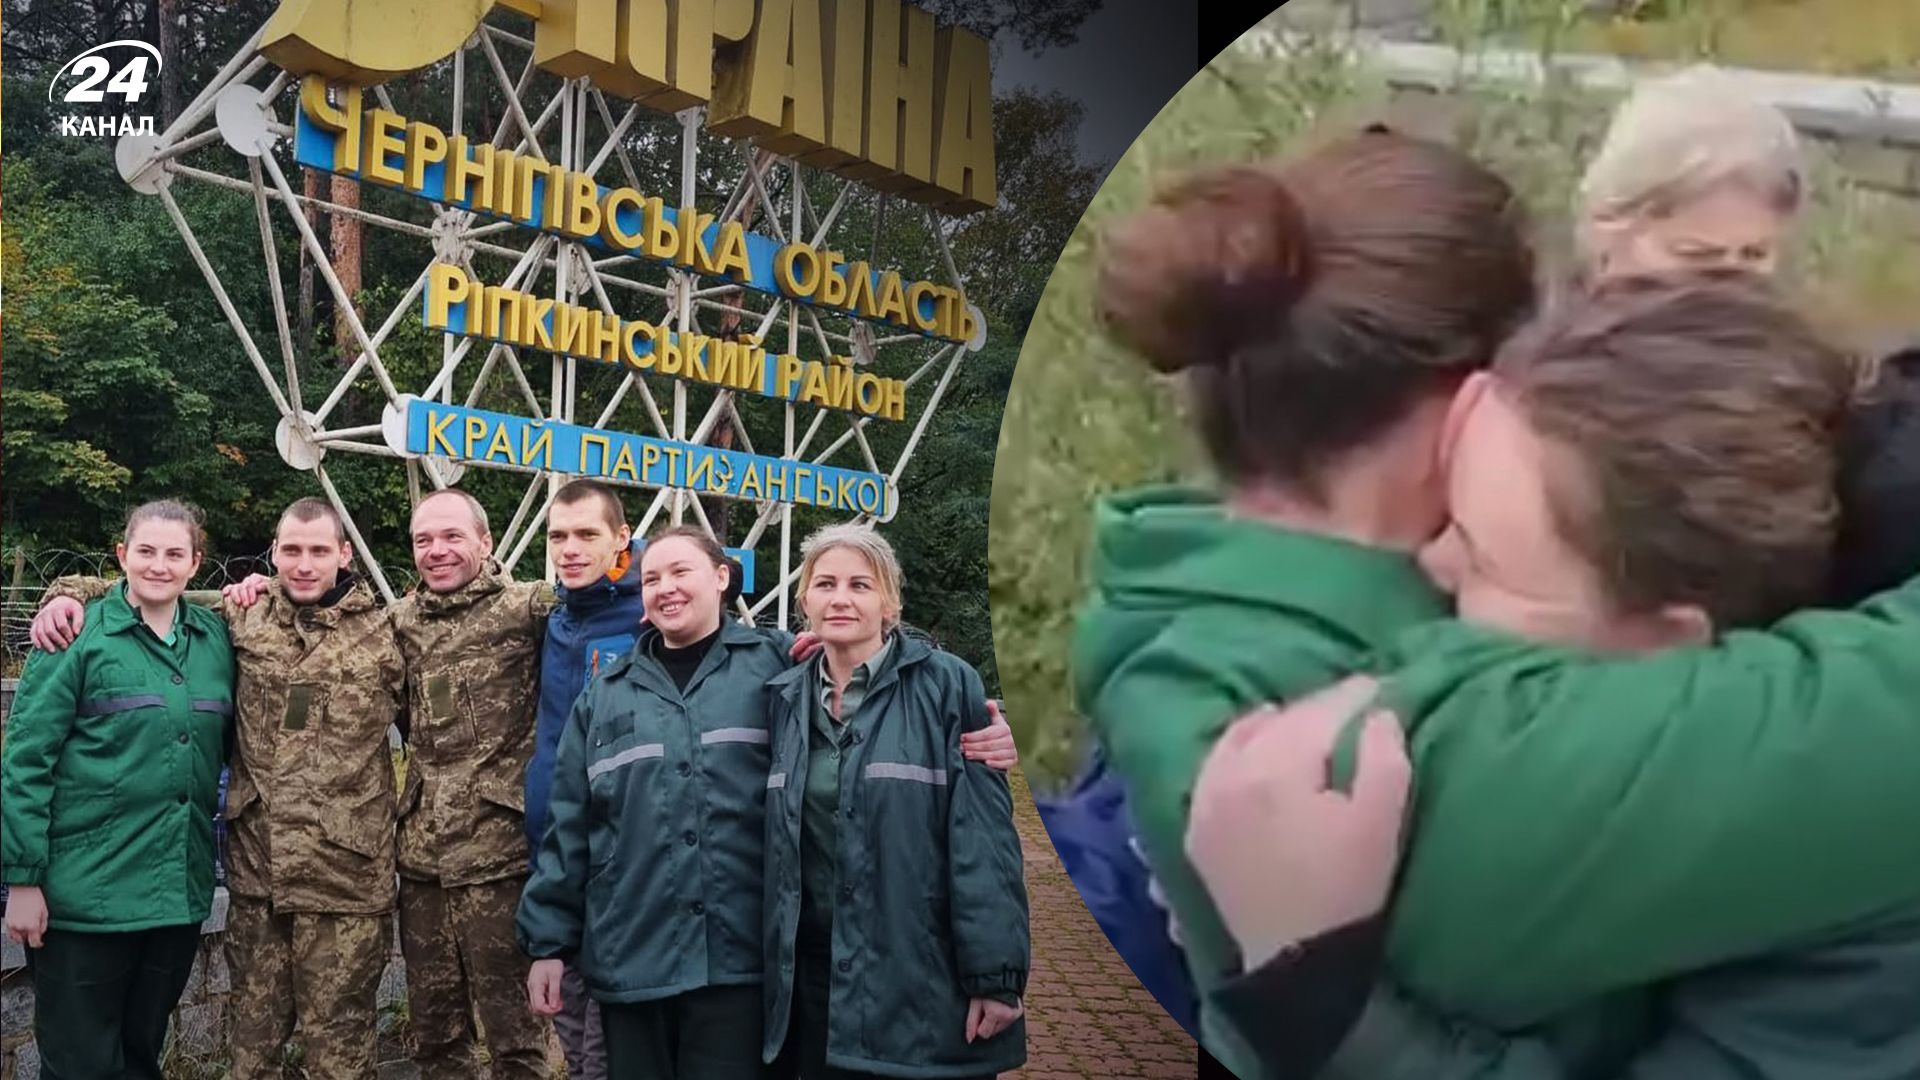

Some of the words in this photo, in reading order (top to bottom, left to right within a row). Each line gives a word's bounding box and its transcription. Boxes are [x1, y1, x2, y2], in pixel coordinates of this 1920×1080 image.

[299, 75, 753, 283] ЧЕРНІГІВСЬКА
[774, 242, 979, 343] ОБЛАСТЬ
[427, 263, 768, 393] РІПКИНСЬКИЙ
[777, 355, 906, 421] РАЙОН
[428, 410, 553, 470] КРАЙ
